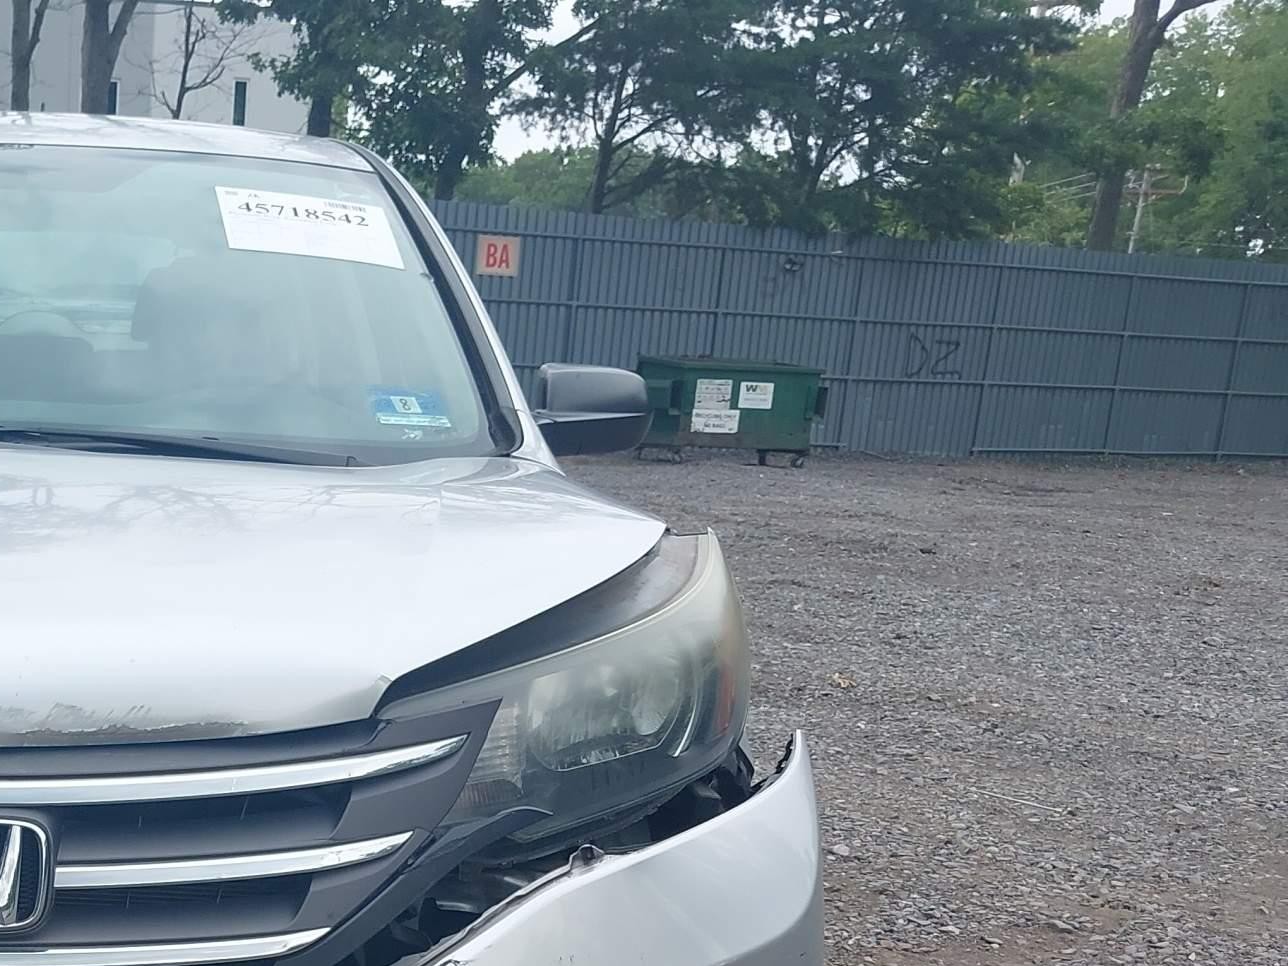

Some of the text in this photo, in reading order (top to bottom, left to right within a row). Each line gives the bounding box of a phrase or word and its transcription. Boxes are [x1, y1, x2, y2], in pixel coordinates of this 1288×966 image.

[238, 202, 369, 227] 45718542
[486, 243, 510, 269] BA
[905, 333, 960, 380] DZ
